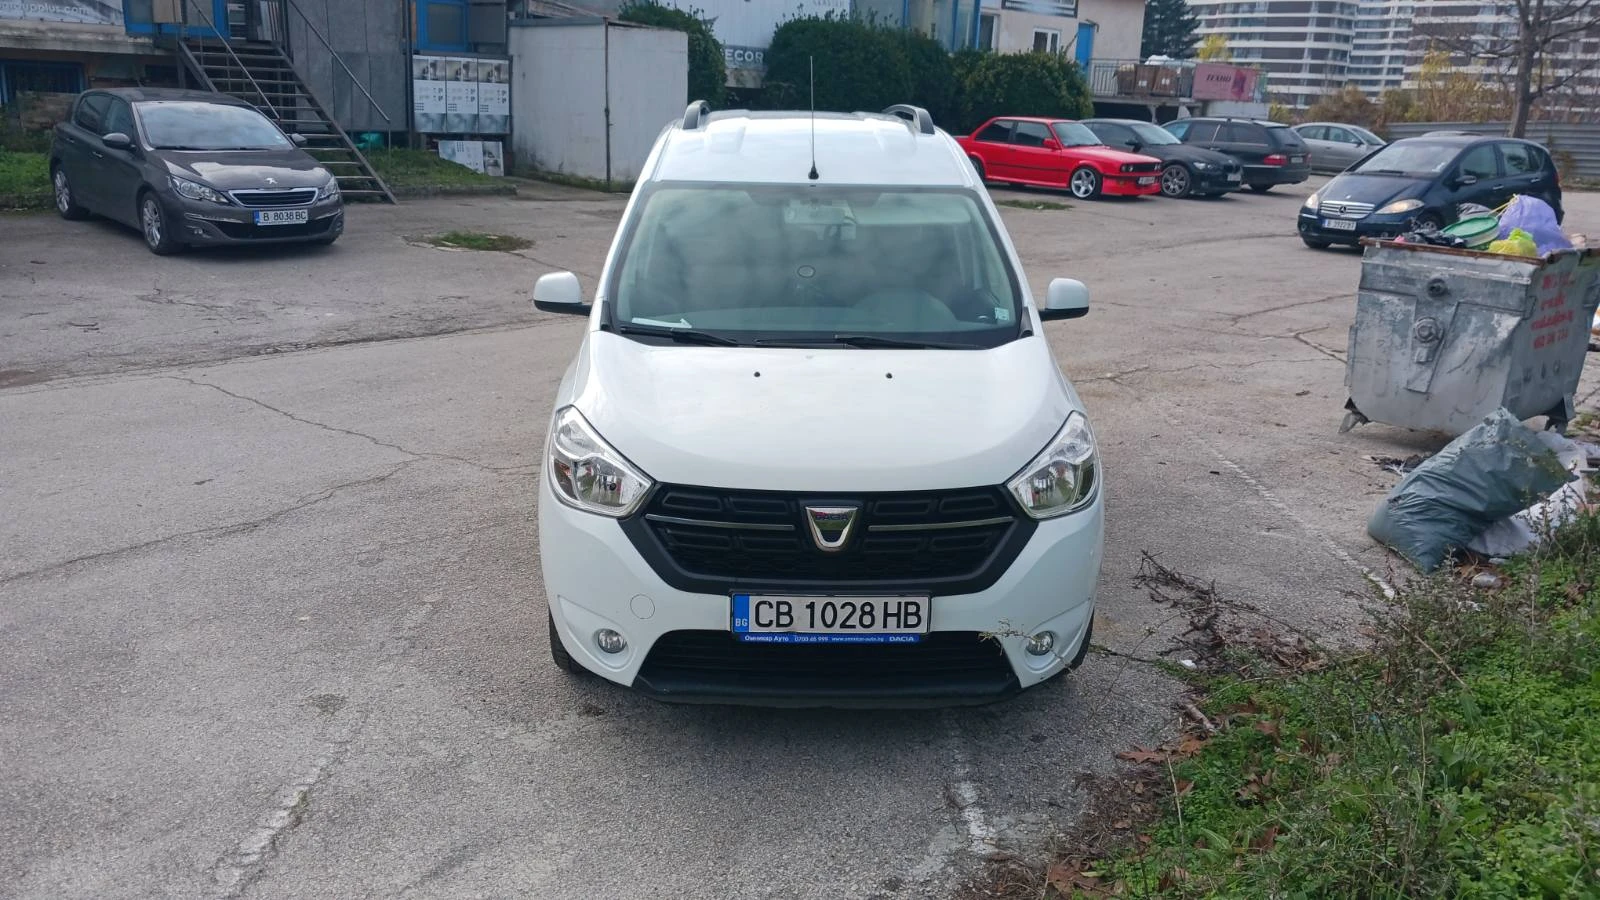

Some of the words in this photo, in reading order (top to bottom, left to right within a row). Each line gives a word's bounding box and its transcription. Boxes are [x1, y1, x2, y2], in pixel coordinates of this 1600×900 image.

[273, 211, 294, 221] 8038
[754, 600, 794, 628] CB
[805, 601, 876, 629] 1028
[882, 601, 922, 629] HB
[735, 618, 748, 627] BG
